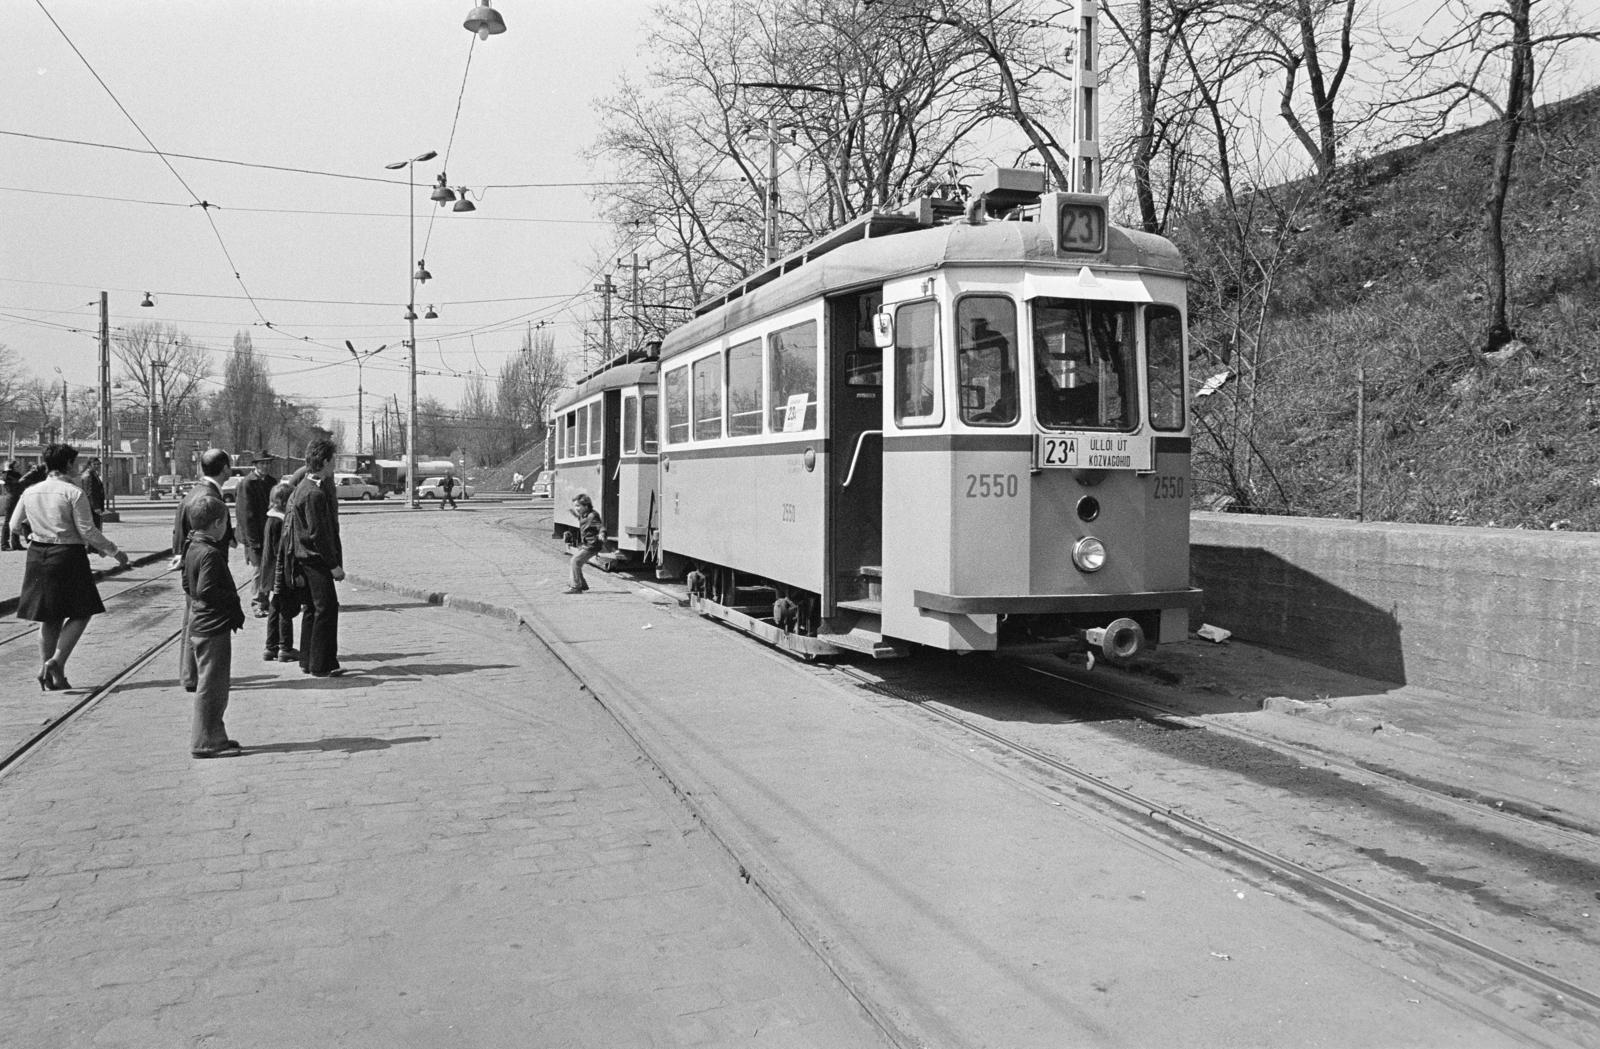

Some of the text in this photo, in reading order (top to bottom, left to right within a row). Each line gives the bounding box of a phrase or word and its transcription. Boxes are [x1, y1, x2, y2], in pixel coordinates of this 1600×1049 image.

[1063, 209, 1093, 243] 23
[1045, 440, 1075, 464] 23A
[966, 474, 1018, 498] 2550
[1153, 476, 1185, 499] 2550
